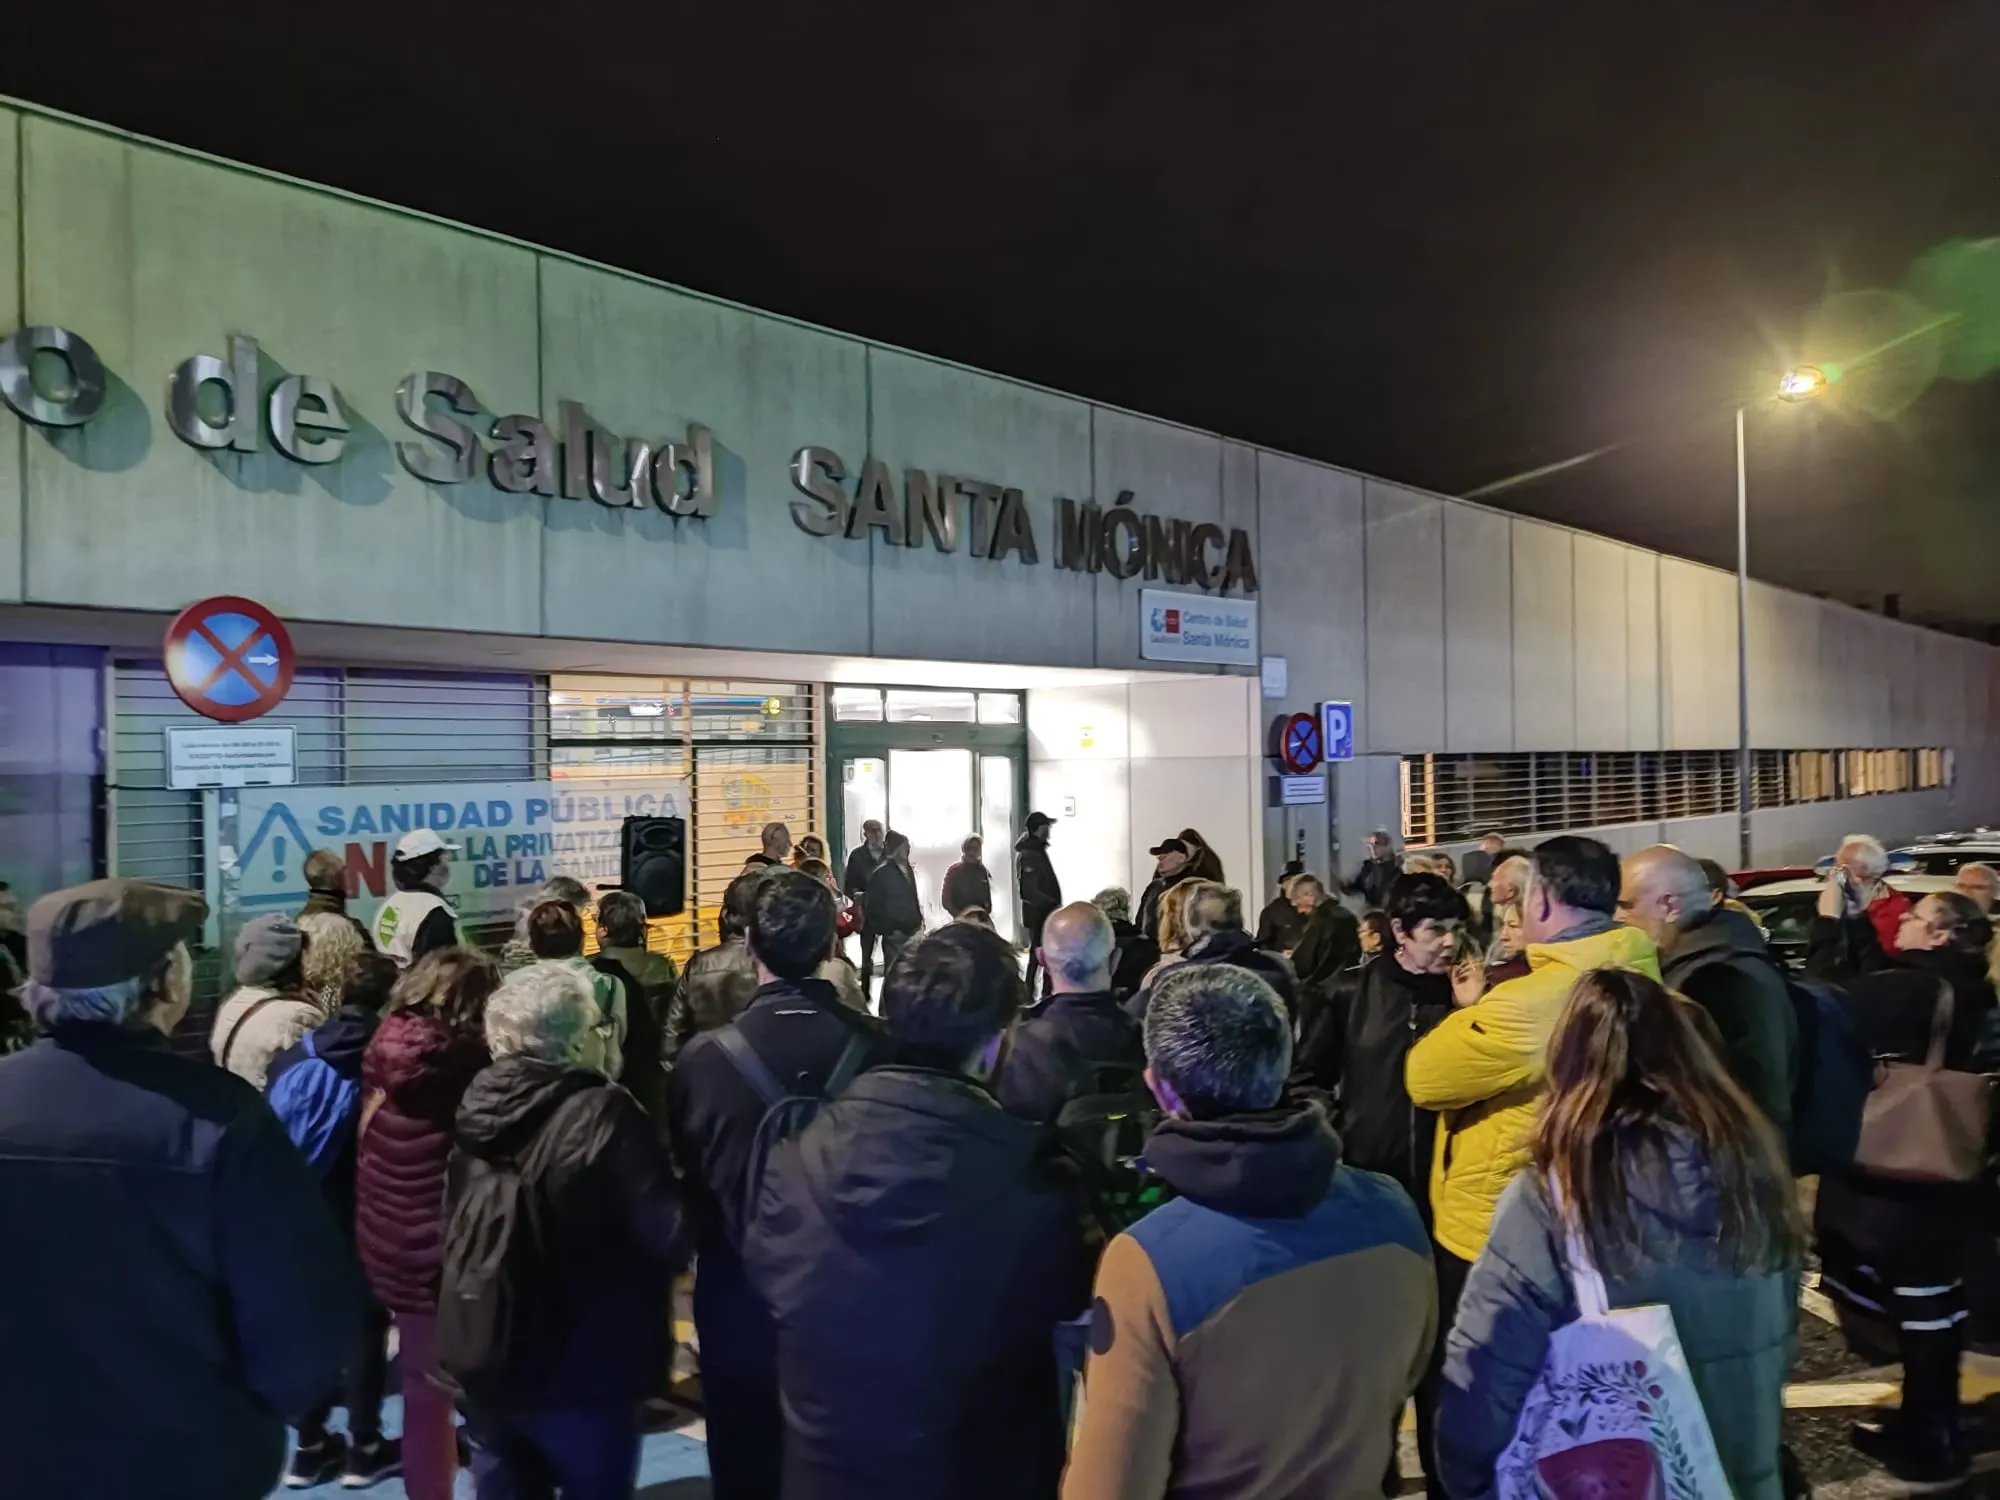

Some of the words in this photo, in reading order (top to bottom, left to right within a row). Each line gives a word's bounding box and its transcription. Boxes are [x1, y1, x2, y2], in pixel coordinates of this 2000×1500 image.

[165, 334, 350, 465] de
[395, 371, 714, 518] Salud
[790, 446, 1040, 565] SANTA
[1053, 490, 1259, 597] MÓNICA
[1183, 631, 1212, 647] Santa
[1330, 709, 1347, 754] P
[316, 800, 513, 836] SANIDAD
[526, 790, 680, 825] PÚBLICA
[466, 835, 498, 861] LA
[475, 862, 508, 889] DE
[516, 859, 546, 886] LA
